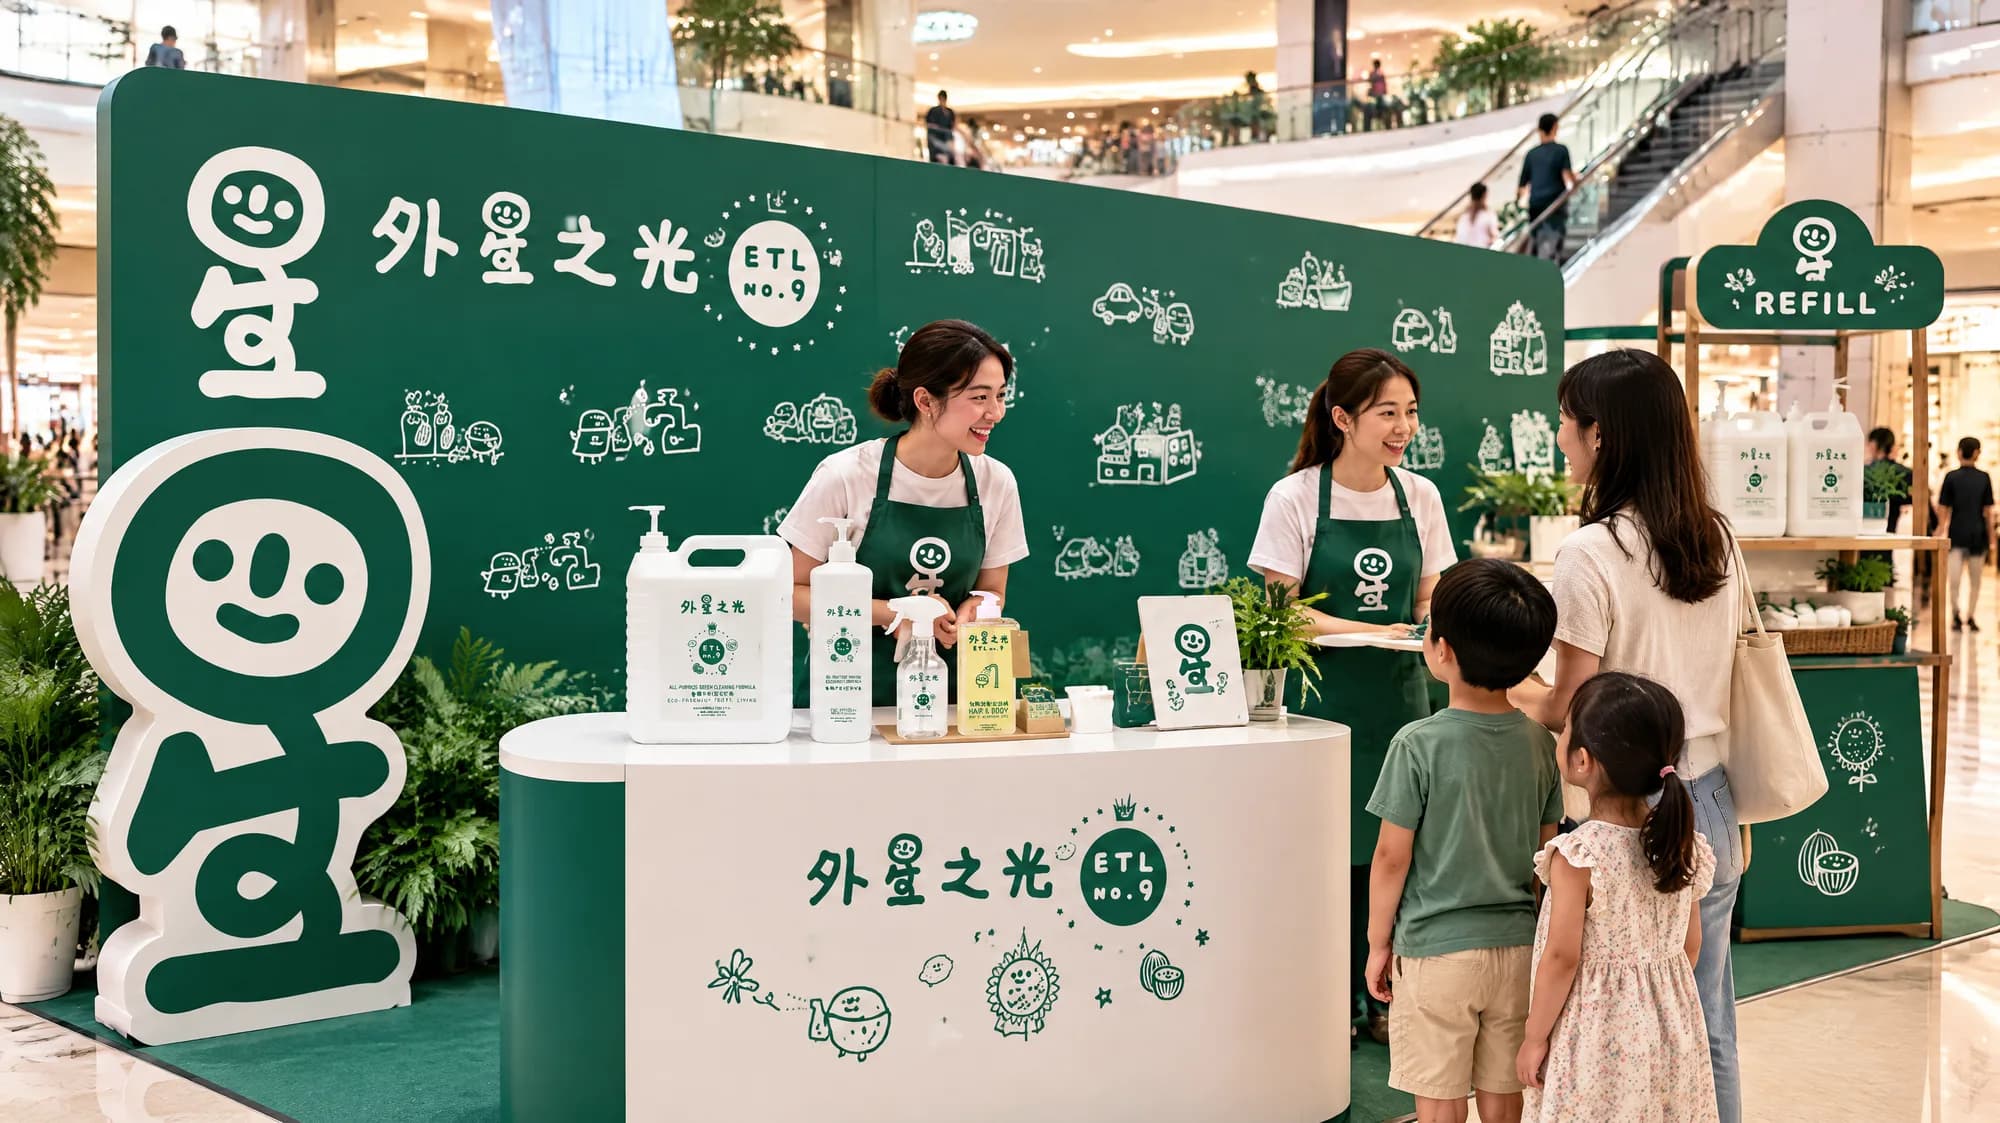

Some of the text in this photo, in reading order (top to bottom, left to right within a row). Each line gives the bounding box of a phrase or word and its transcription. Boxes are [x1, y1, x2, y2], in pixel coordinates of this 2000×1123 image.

[745, 245, 806, 271] ETL
[1755, 291, 1876, 315] REFILL
[806, 833, 1053, 907] 外星之光
[1094, 851, 1154, 873] ETL
